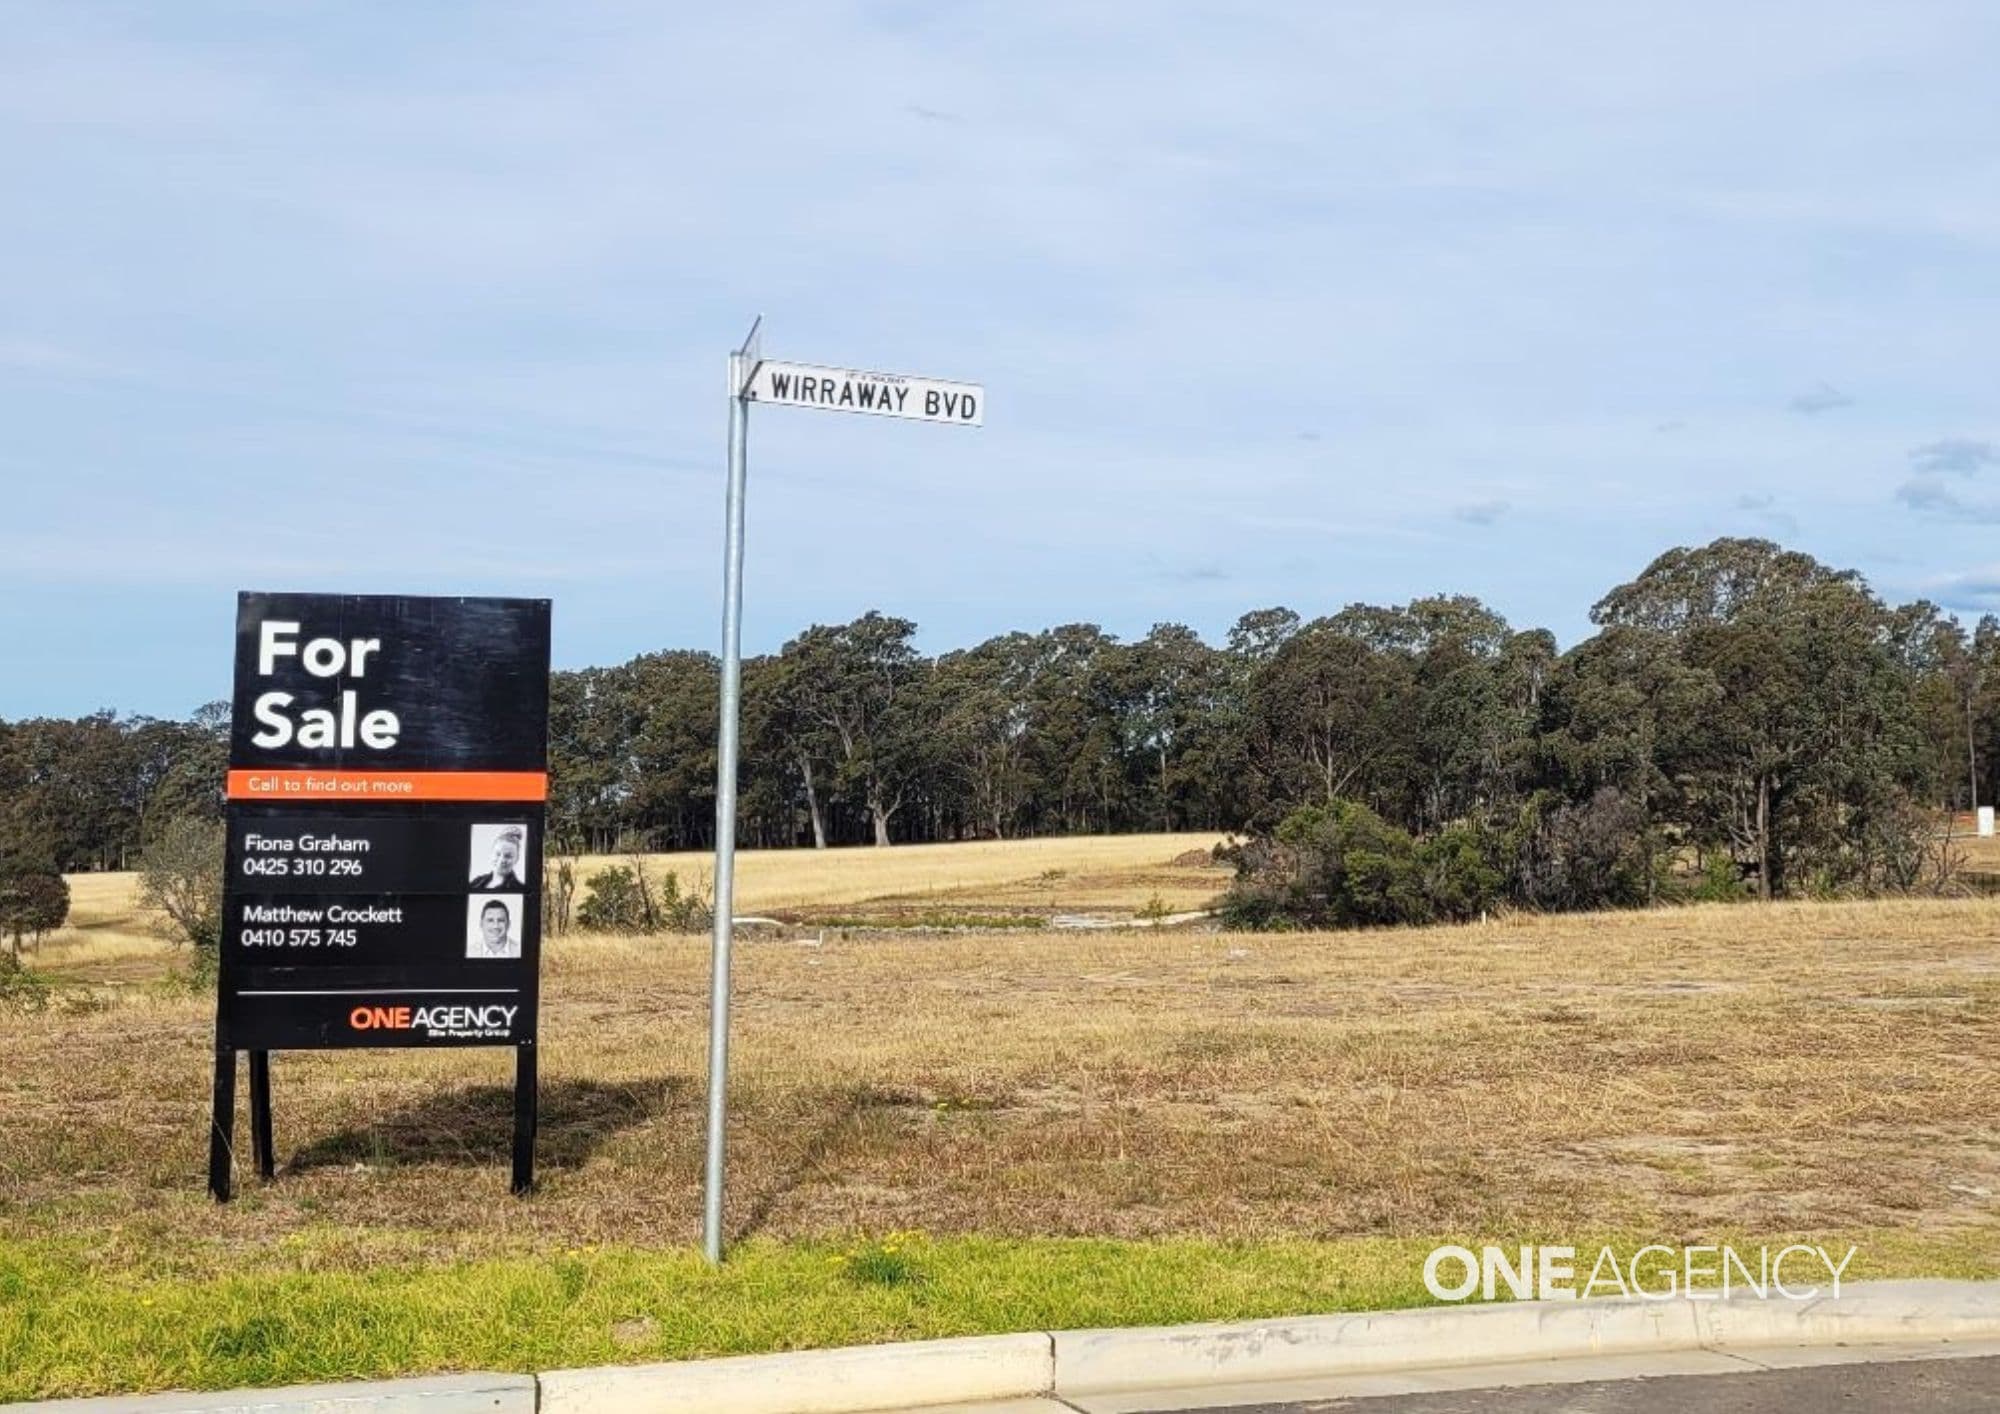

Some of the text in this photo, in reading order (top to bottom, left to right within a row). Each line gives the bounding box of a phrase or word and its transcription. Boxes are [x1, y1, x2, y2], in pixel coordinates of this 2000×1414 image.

[771, 372, 976, 419] WIRRAWAY BVD
[259, 620, 380, 677] For
[251, 689, 400, 749] Sale
[248, 777, 412, 793] Call to find out more
[245, 834, 369, 852] Fiona Graham
[243, 858, 362, 875] 0425 310 296
[243, 905, 402, 923] Matthew Crockett
[241, 930, 356, 947] 0410 575 745
